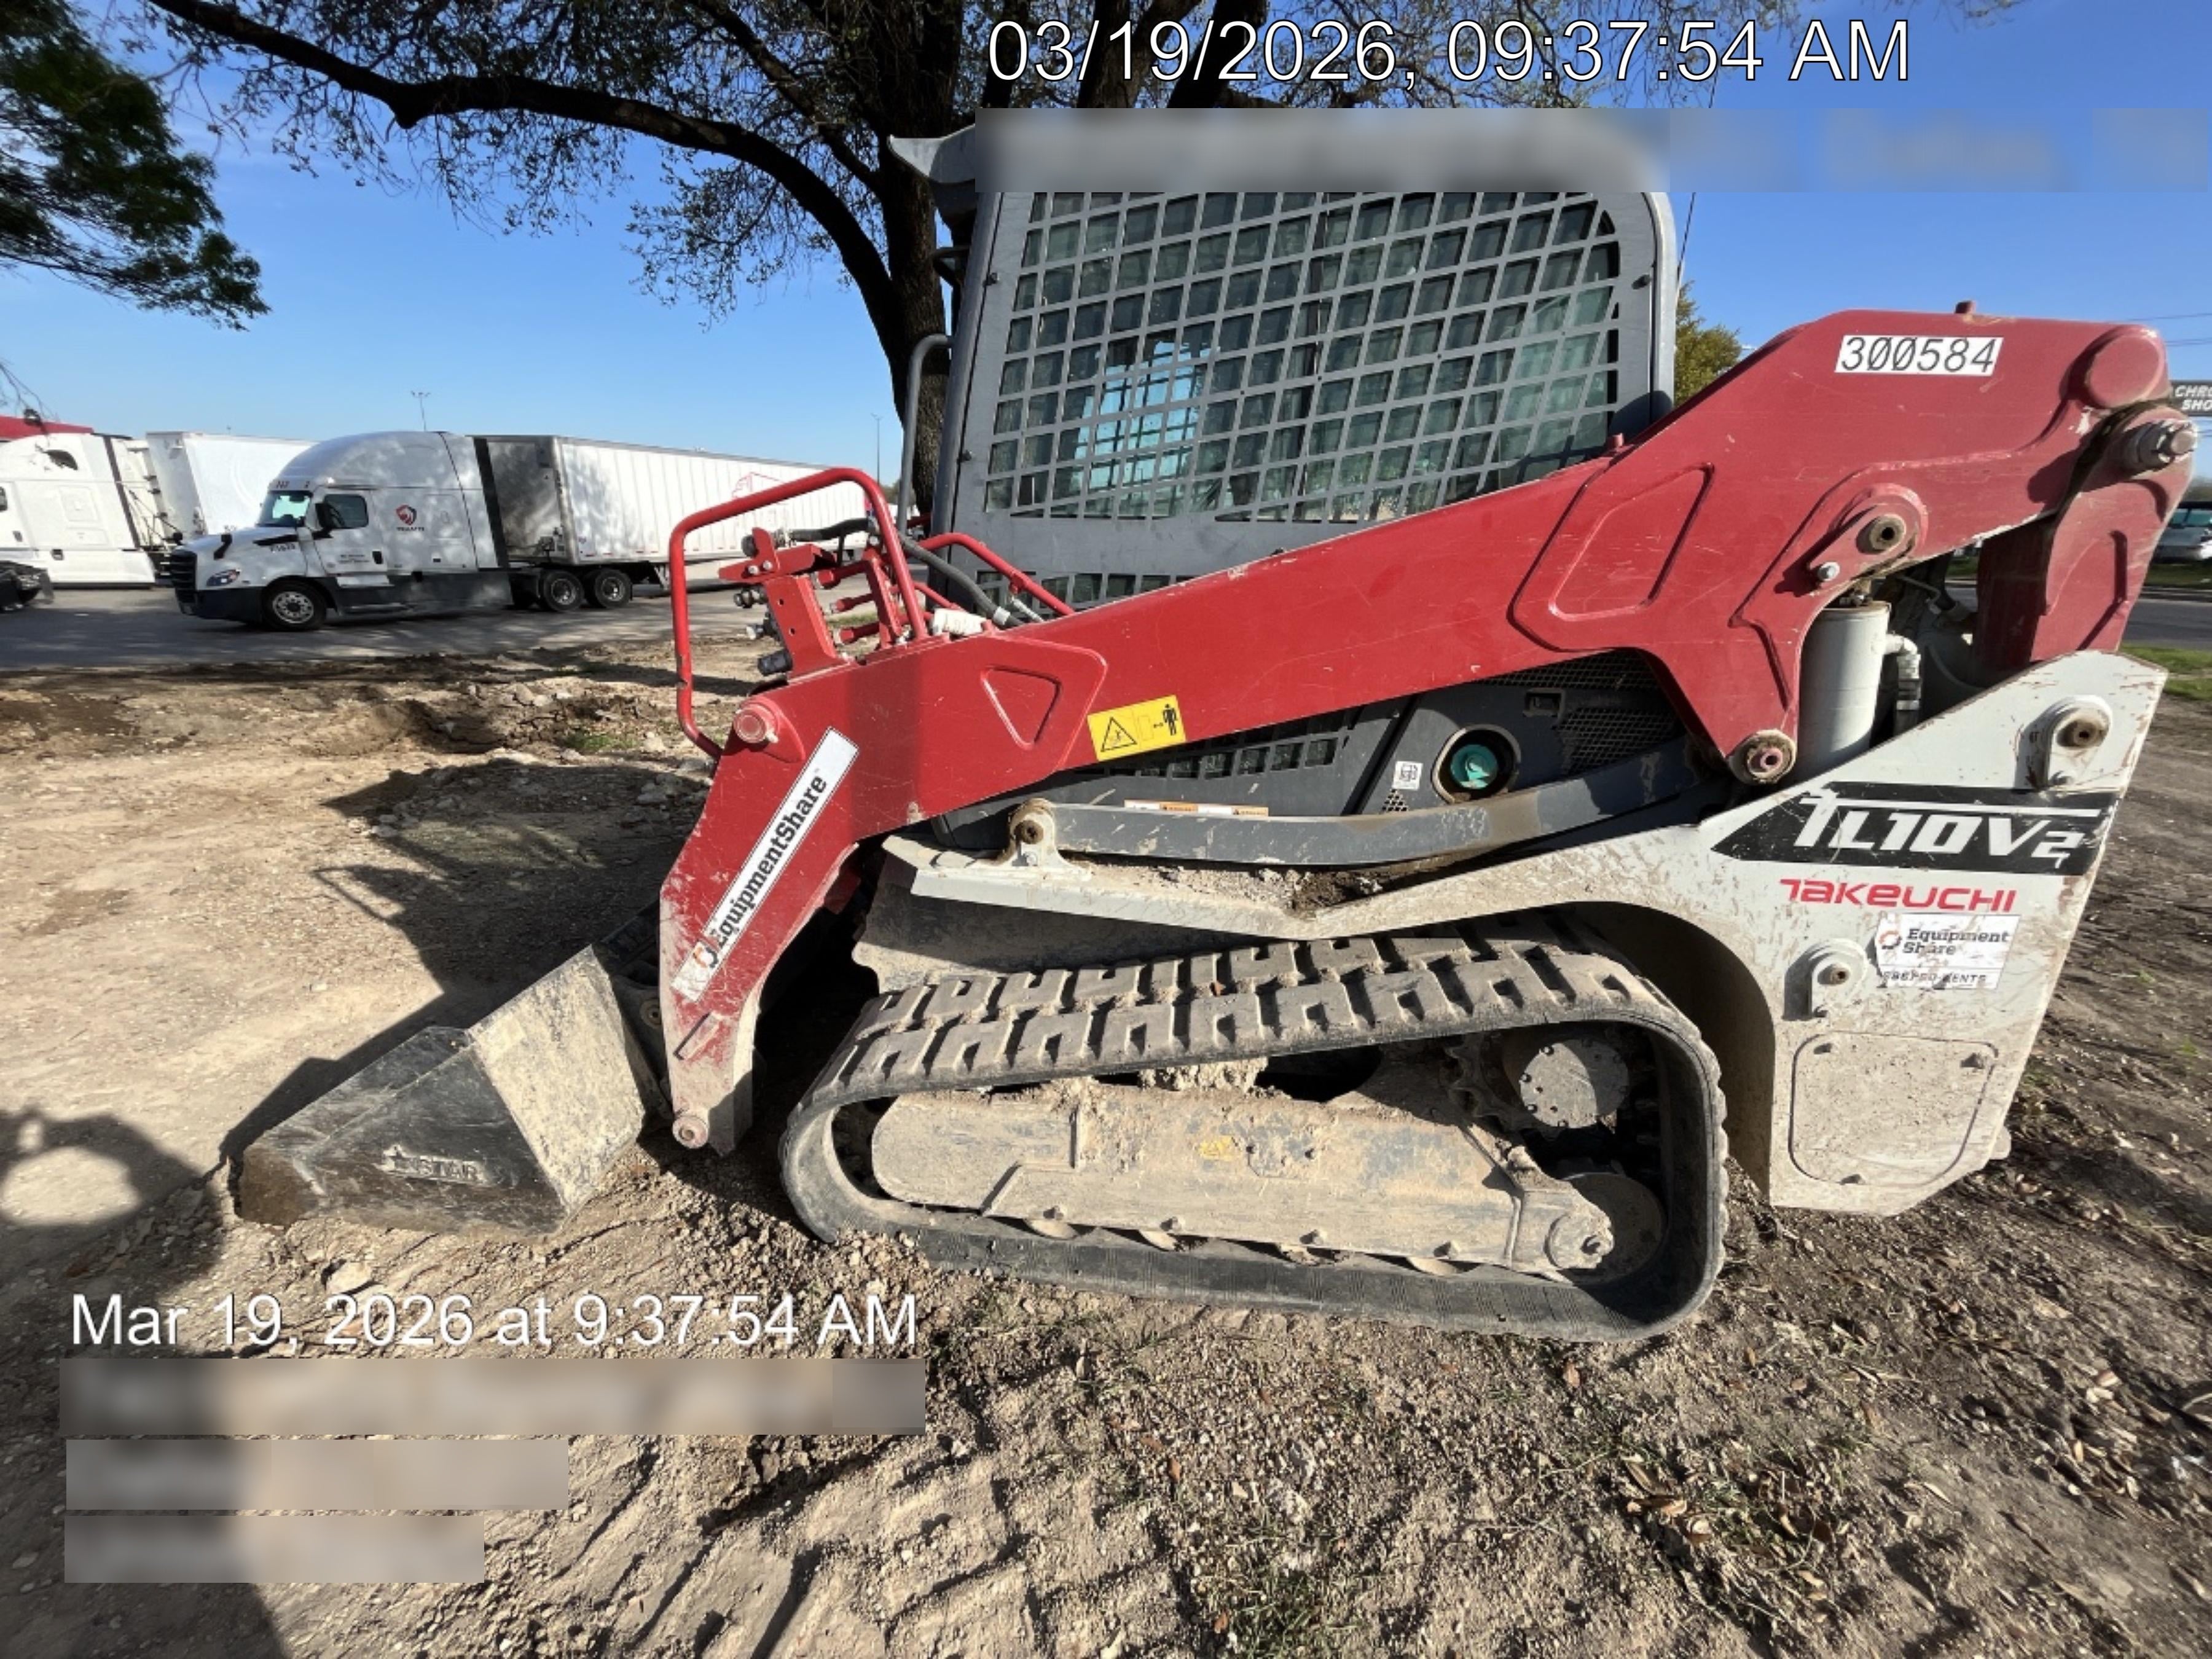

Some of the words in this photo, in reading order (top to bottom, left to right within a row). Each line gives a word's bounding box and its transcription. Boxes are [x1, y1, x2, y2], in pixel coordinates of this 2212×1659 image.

[1841, 336, 1996, 372] 300584
[708, 774, 828, 949] EquipmentShare
[1902, 941, 1957, 956] Share
[1906, 928, 2010, 944] Equipment
